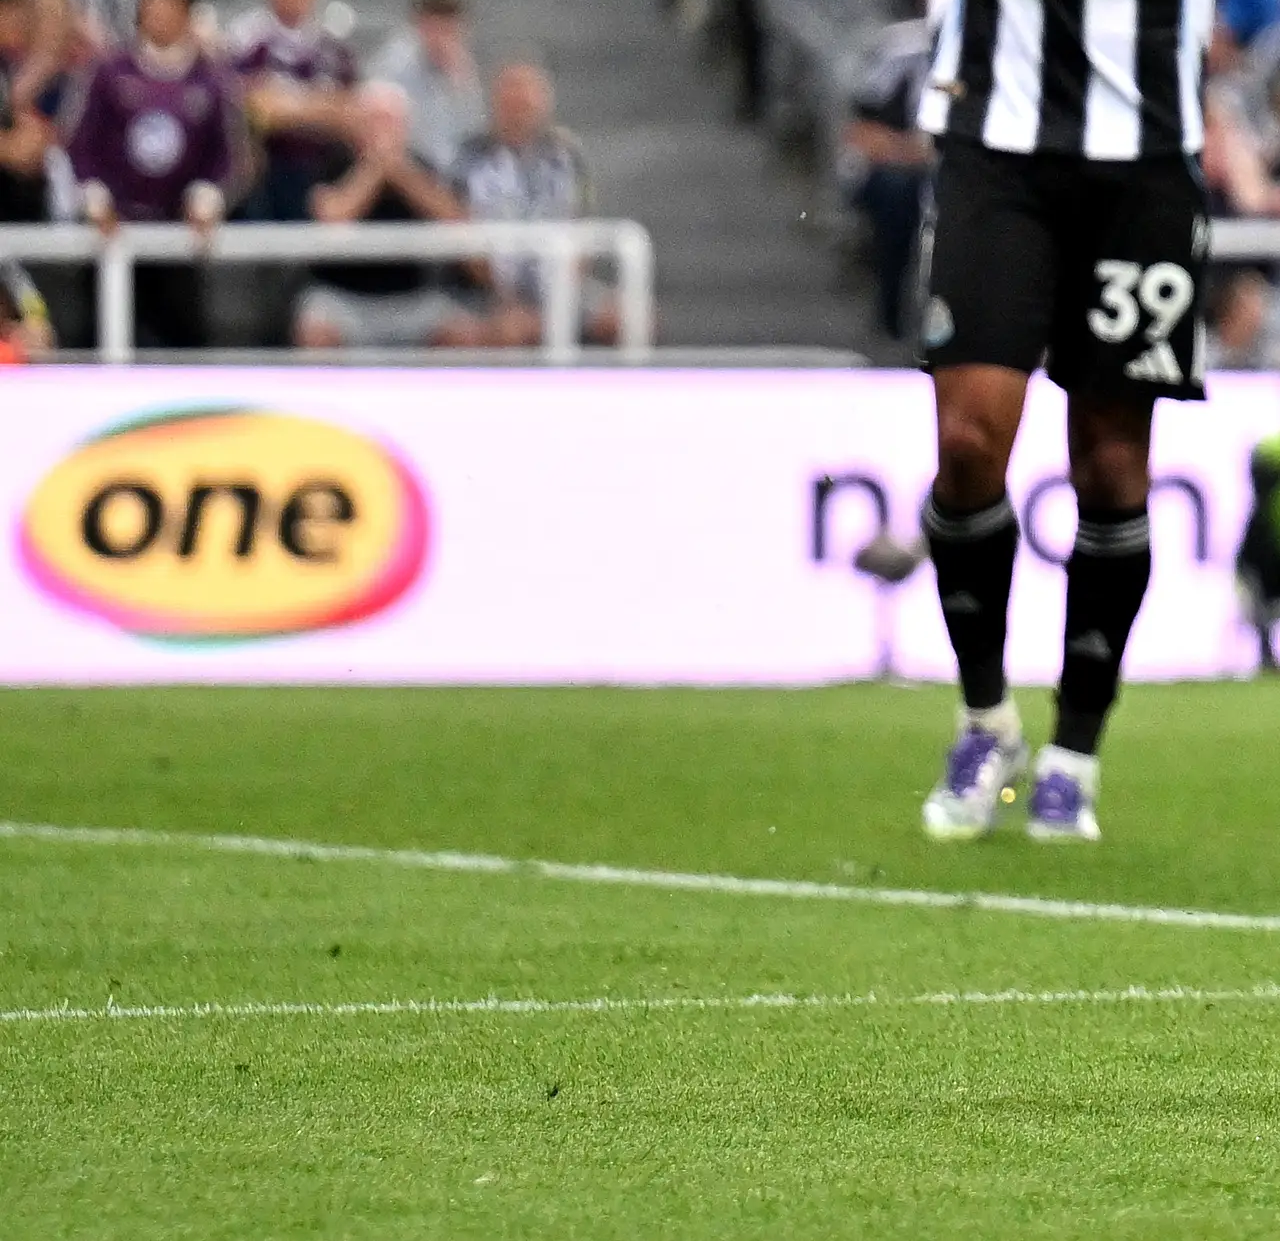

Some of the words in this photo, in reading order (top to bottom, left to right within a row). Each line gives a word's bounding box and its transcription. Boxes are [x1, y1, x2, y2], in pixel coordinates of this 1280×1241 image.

[1087, 258, 1195, 344] 39
[81, 480, 357, 562] one
[813, 475, 1208, 565] non
